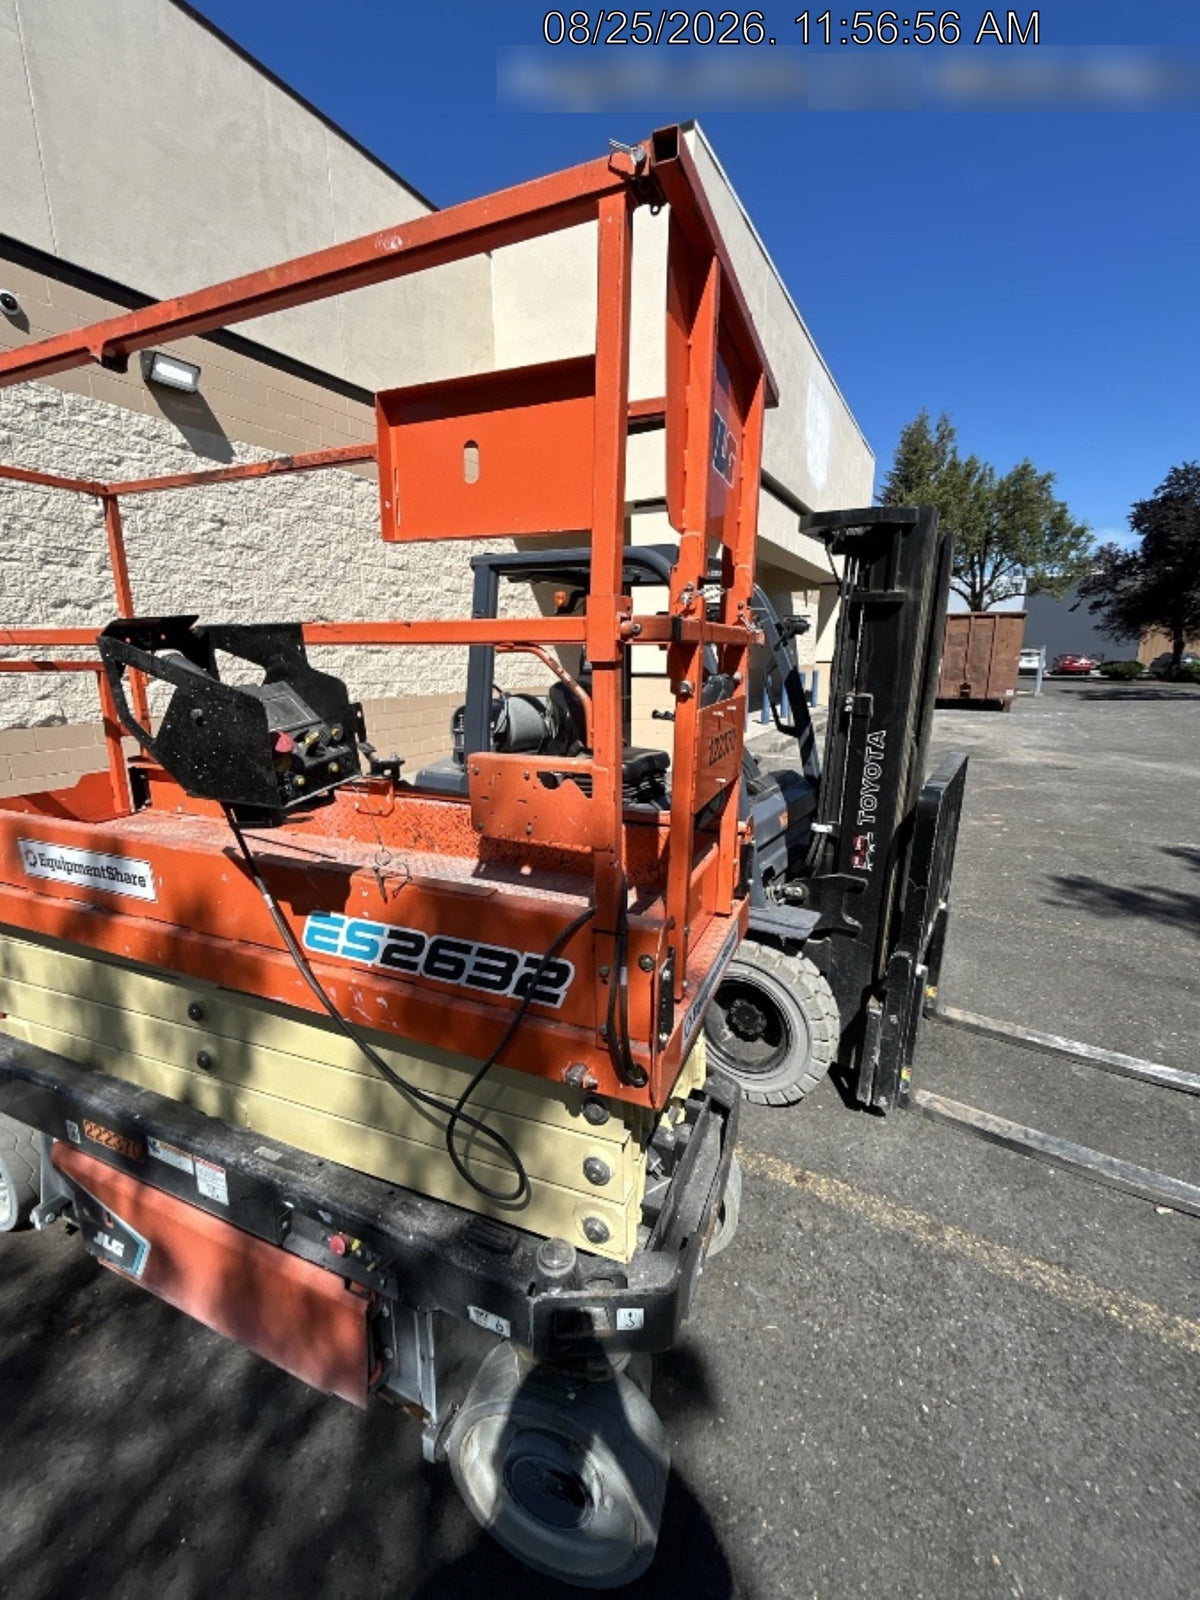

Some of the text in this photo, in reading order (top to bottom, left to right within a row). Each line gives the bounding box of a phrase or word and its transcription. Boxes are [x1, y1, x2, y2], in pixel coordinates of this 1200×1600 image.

[857, 730, 886, 825] TOYOTA
[38, 852, 147, 888] EquipmentShare
[305, 910, 573, 1006] ES2632
[92, 1231, 125, 1258] JLG
